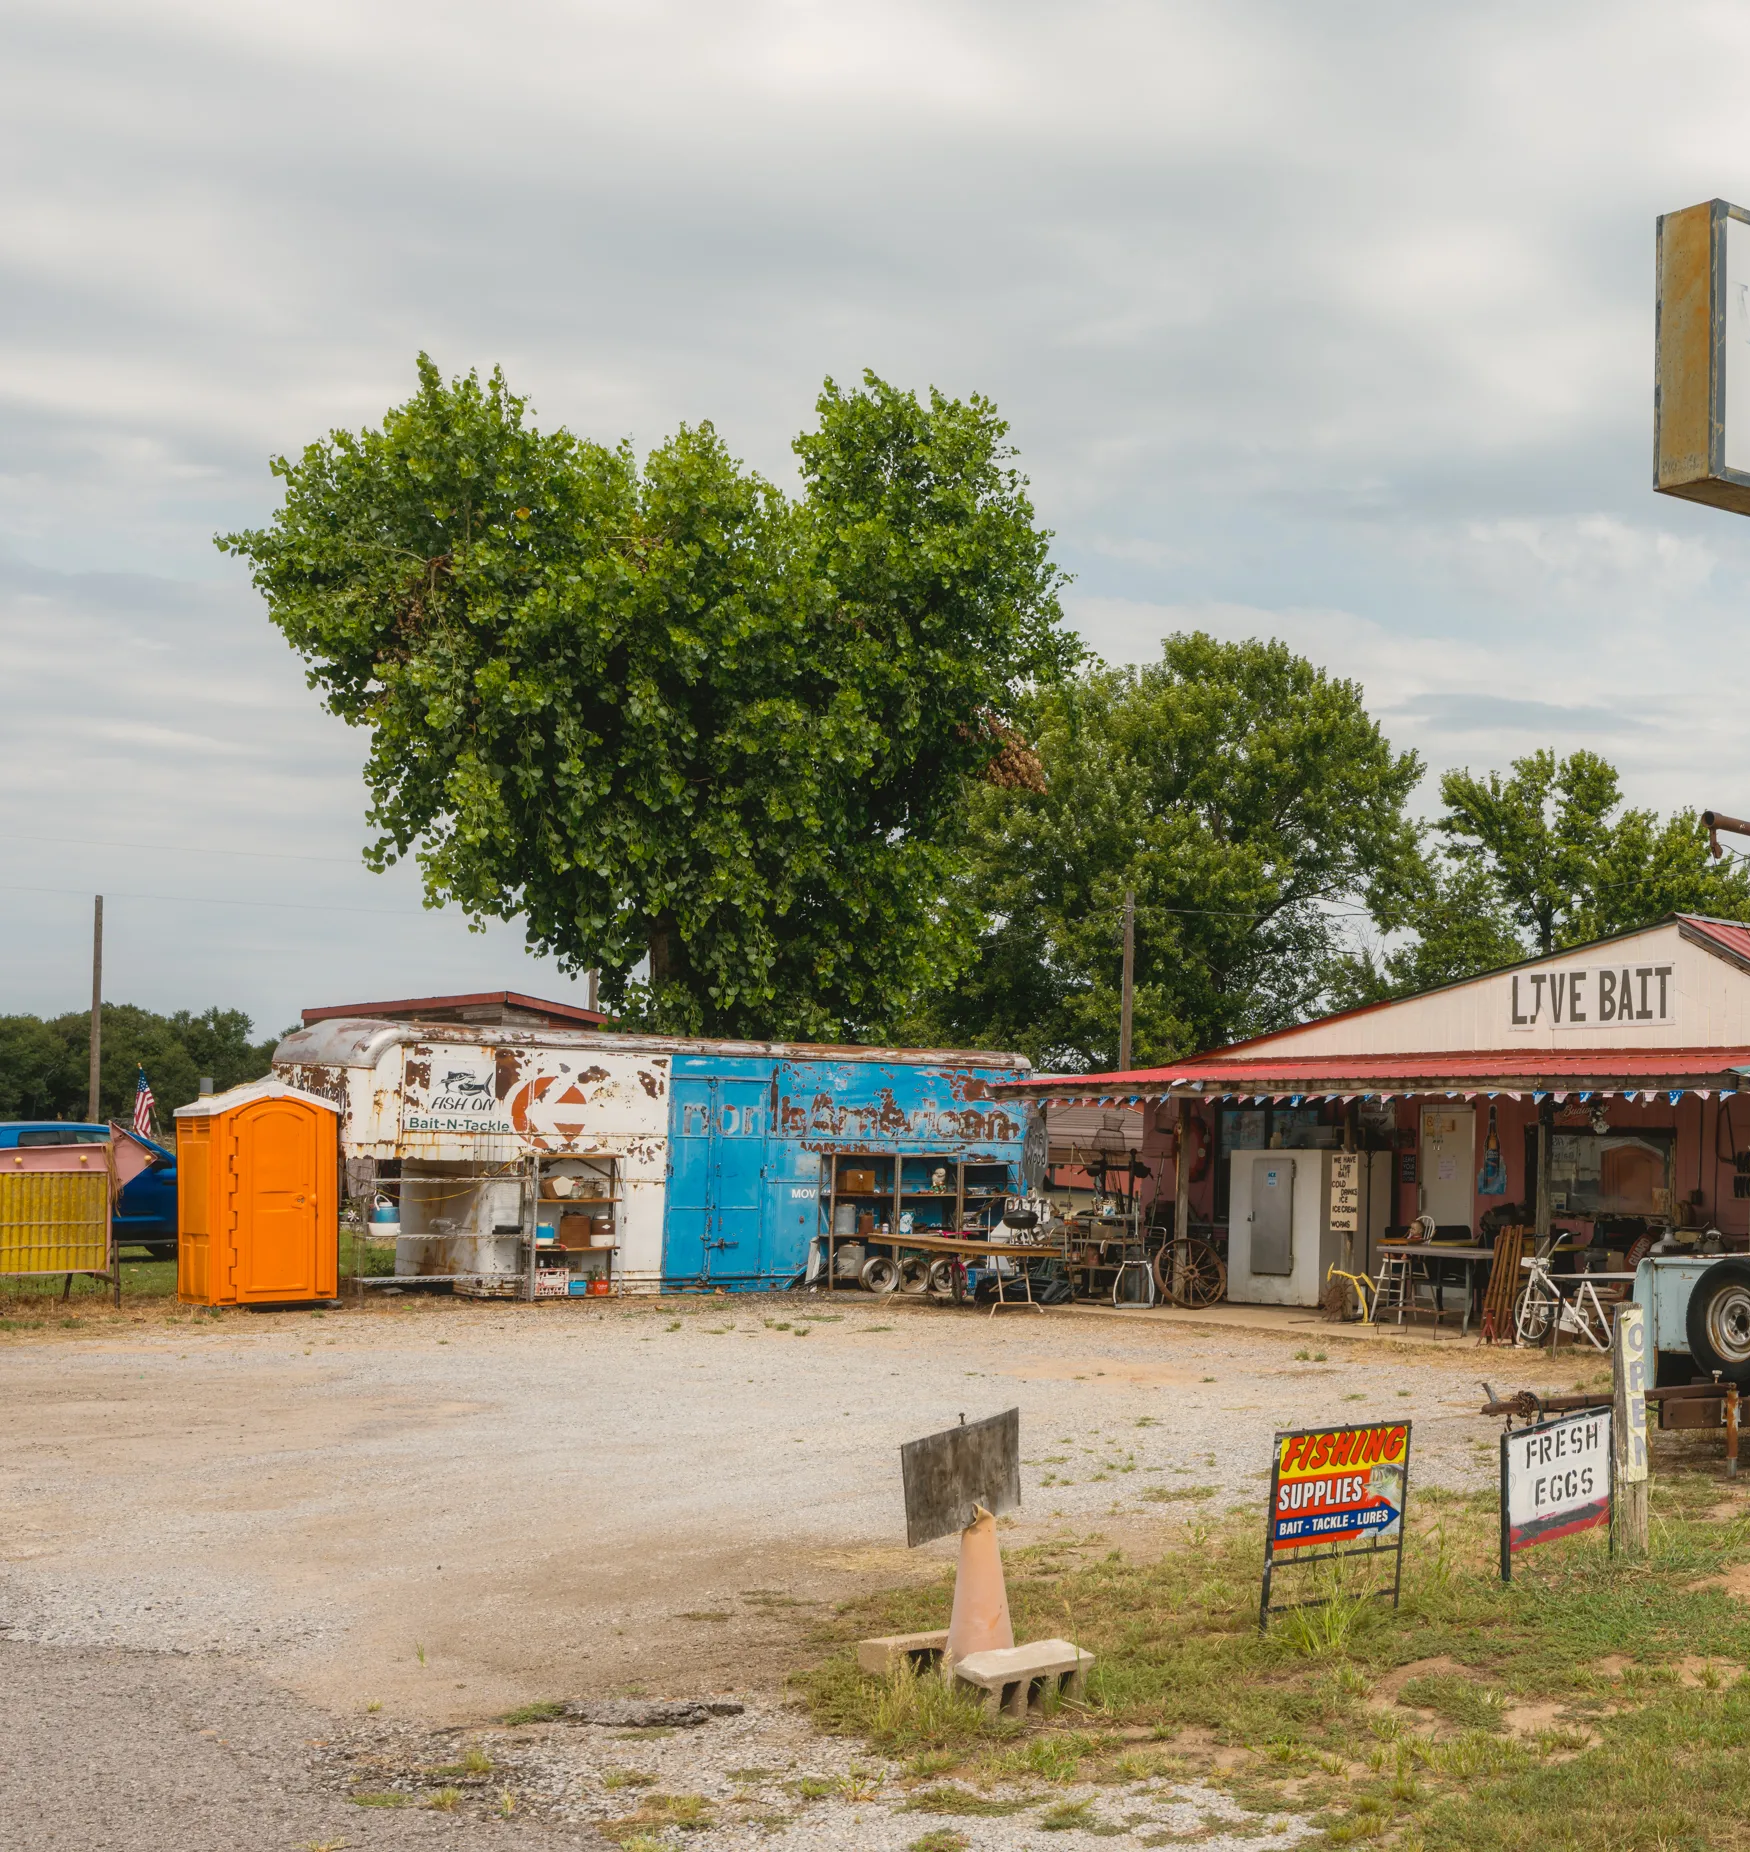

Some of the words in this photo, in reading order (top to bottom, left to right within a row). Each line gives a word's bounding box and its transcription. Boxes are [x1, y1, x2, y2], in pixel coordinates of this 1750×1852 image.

[1511, 972, 1586, 1025] LIVE
[1599, 966, 1672, 1021] BAIT
[431, 1097, 466, 1111] FISH
[471, 1097, 495, 1111] ON
[408, 1116, 510, 1133] Bait-N-Tackle
[1026, 1150, 1046, 1165] Wood
[1628, 1323, 1646, 1466] OPEN
[1281, 1426, 1406, 1472] FISHING
[1526, 1422, 1599, 1469] FRESH
[1278, 1476, 1363, 1511] SUPPLIES
[1535, 1467, 1594, 1507] EGGS
[1279, 1521, 1303, 1536] BAIT
[1312, 1515, 1349, 1530] TACKLE
[1357, 1510, 1389, 1525] LURES
